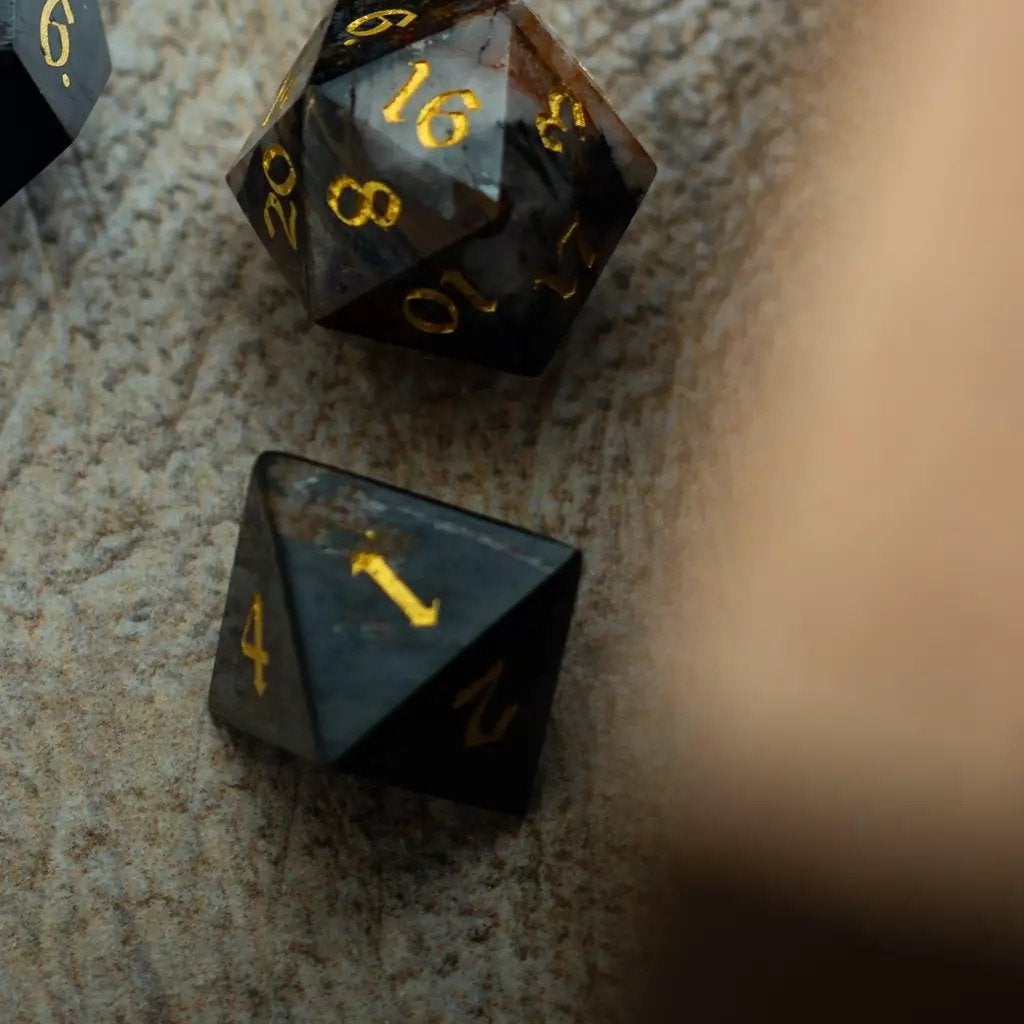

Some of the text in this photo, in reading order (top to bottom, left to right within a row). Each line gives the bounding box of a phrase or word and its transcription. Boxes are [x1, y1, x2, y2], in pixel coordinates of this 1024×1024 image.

[382, 58, 483, 149] 16
[262, 142, 299, 251] 20
[326, 175, 403, 231] 8
[403, 270, 500, 336] 10
[350, 551, 441, 627] 1
[240, 592, 270, 699] 4
